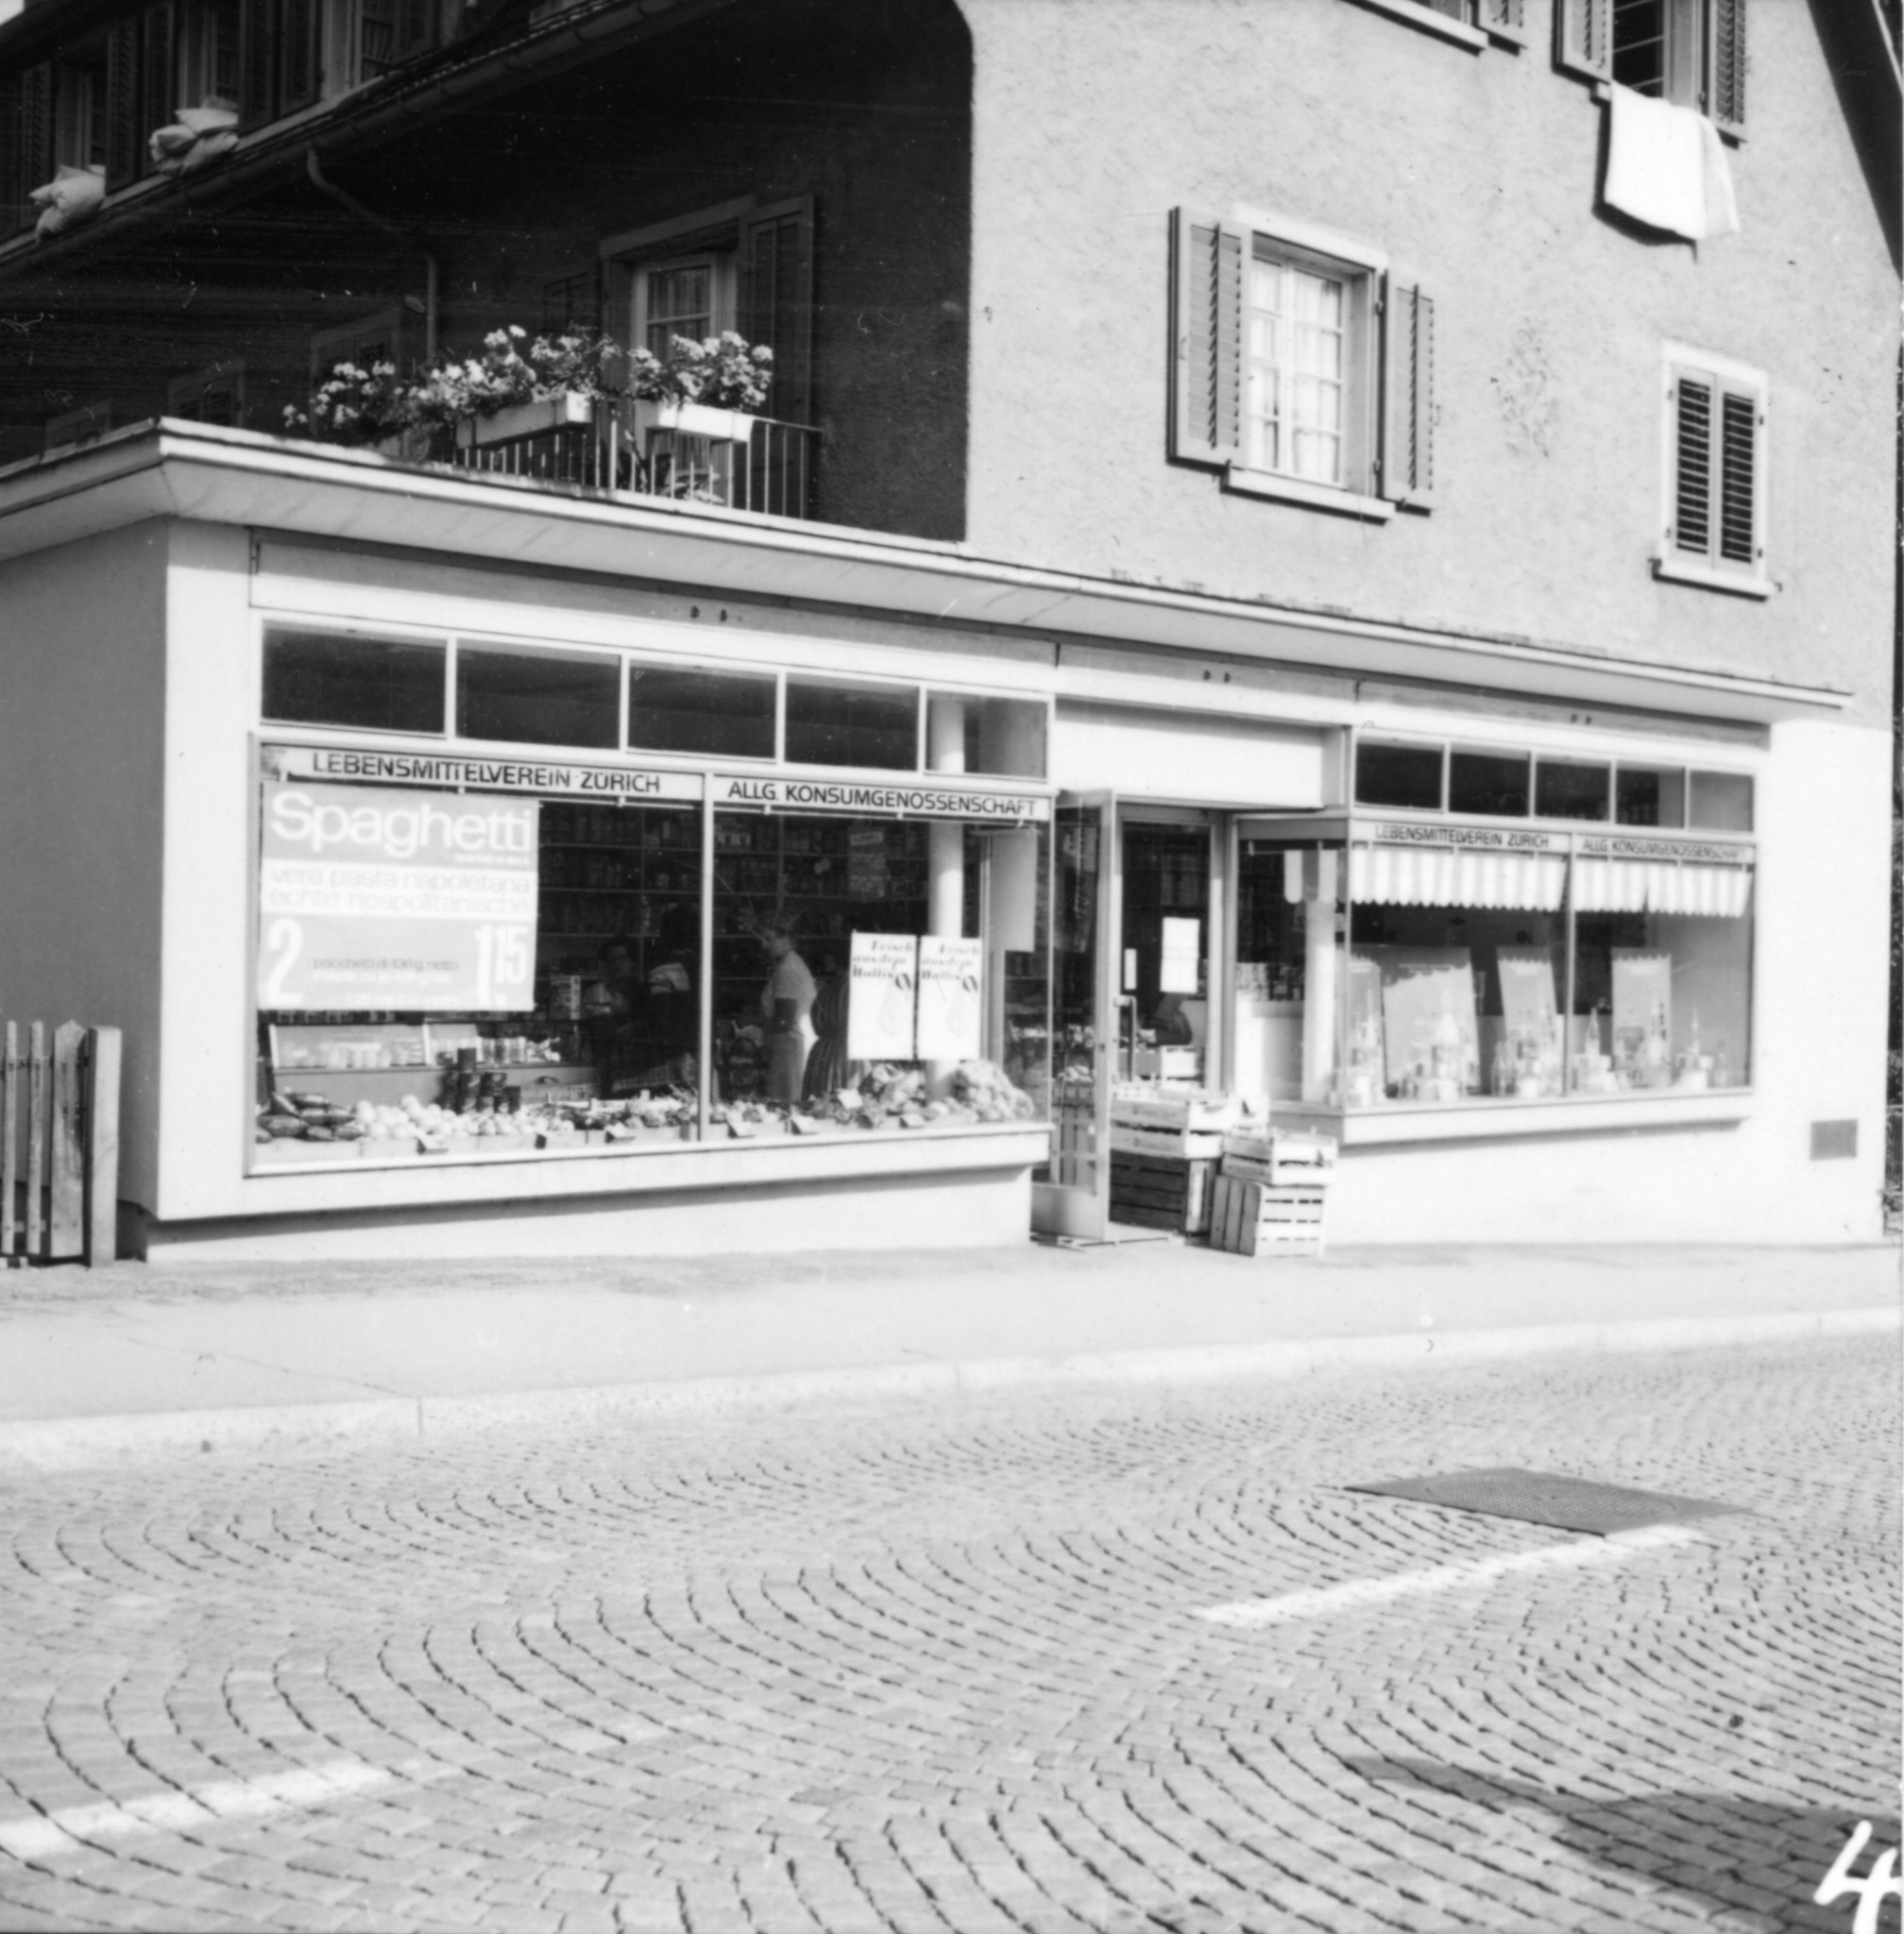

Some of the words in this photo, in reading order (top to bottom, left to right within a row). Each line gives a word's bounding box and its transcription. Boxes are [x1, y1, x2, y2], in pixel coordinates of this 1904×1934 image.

[312, 751, 571, 789] LEBENSMITTELVEREIN
[579, 770, 661, 793] ZÜRICH
[727, 781, 780, 802] ALLG.
[786, 784, 1038, 818] KONSUMGENOSSENSCHAFT
[271, 790, 532, 858] Spaghetti
[1375, 823, 1503, 846] LEBENSMITTELVEREIN
[272, 866, 322, 884] vera
[330, 870, 397, 890] pasta
[403, 871, 531, 895] napoletana
[267, 917, 304, 1007] 2
